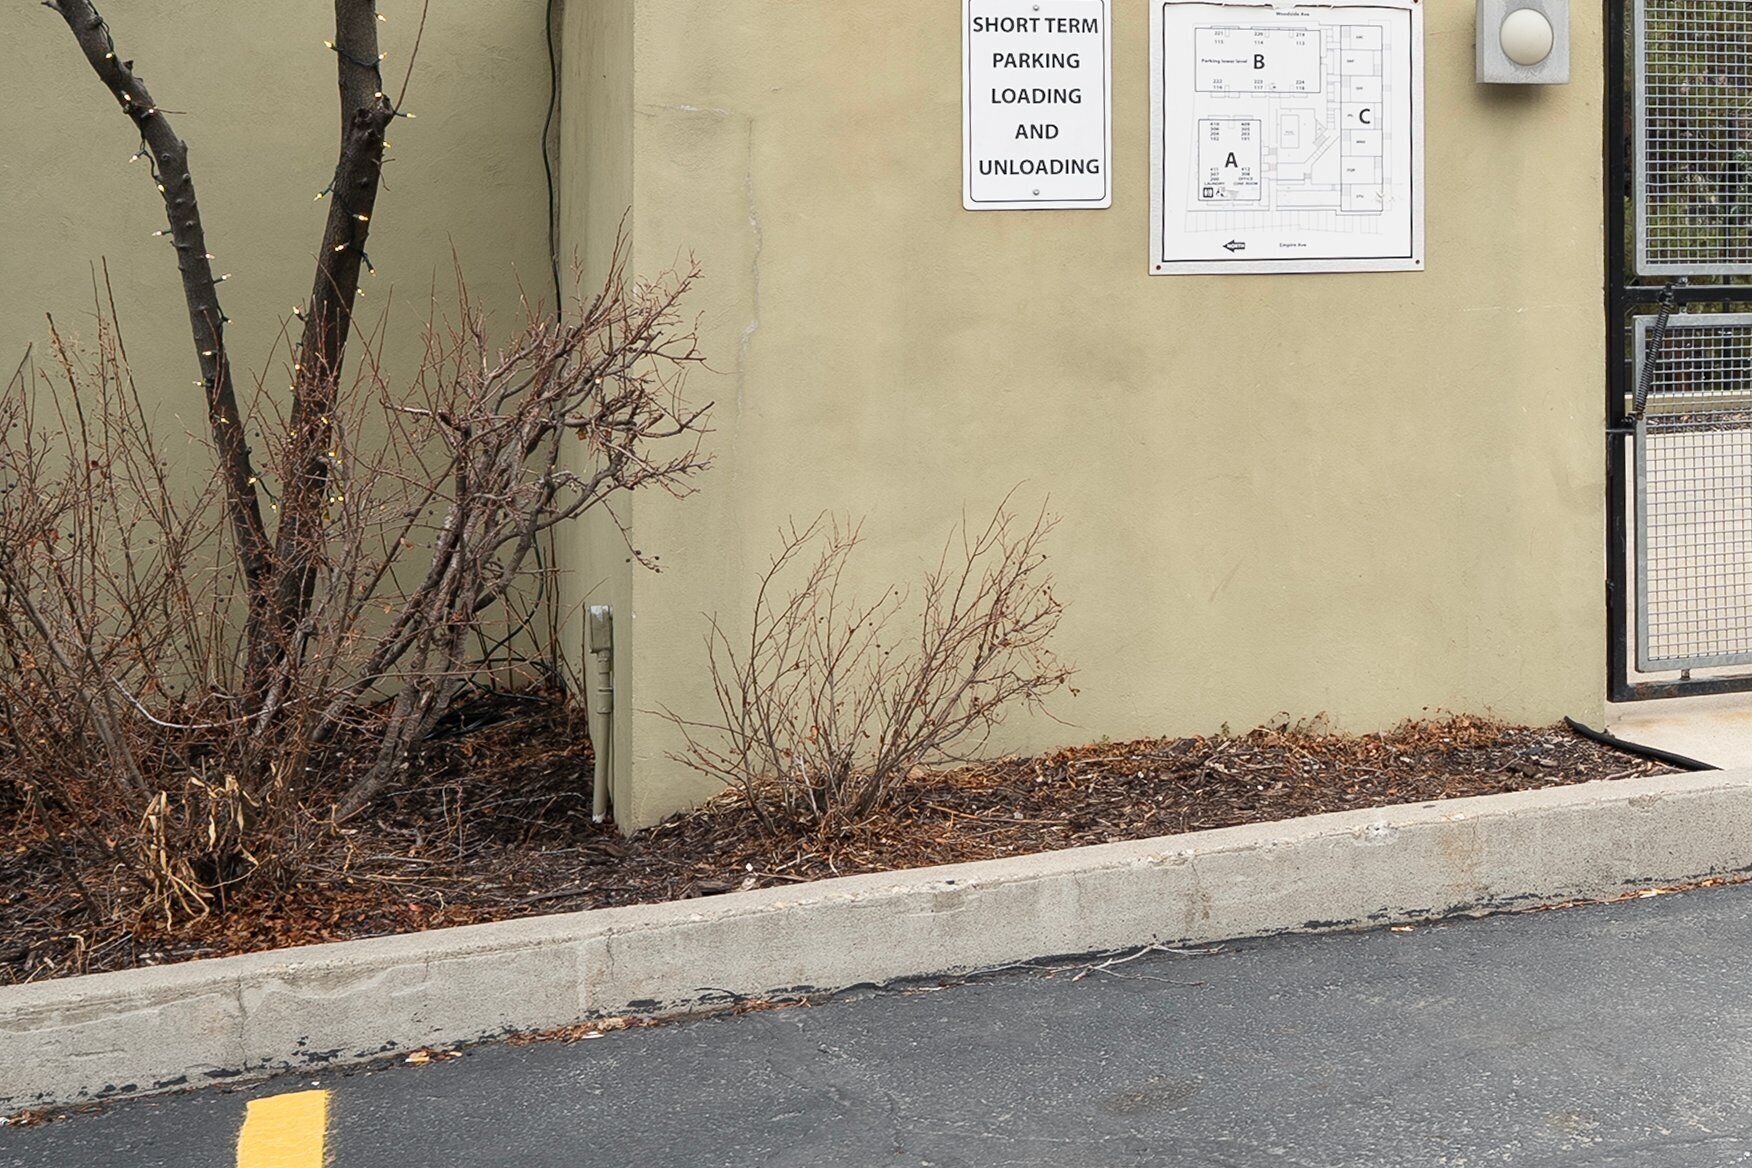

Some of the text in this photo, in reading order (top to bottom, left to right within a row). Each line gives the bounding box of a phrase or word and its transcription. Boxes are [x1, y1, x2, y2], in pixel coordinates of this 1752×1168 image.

[973, 17, 1098, 34] SHORT TERM
[994, 52, 1080, 69] PARKING
[1253, 54, 1265, 70] B
[992, 88, 1082, 104] LOADING
[1359, 108, 1371, 125] C
[1015, 124, 1059, 140] AND
[980, 158, 1100, 176] UNLOADING
[1225, 151, 1238, 168] A
